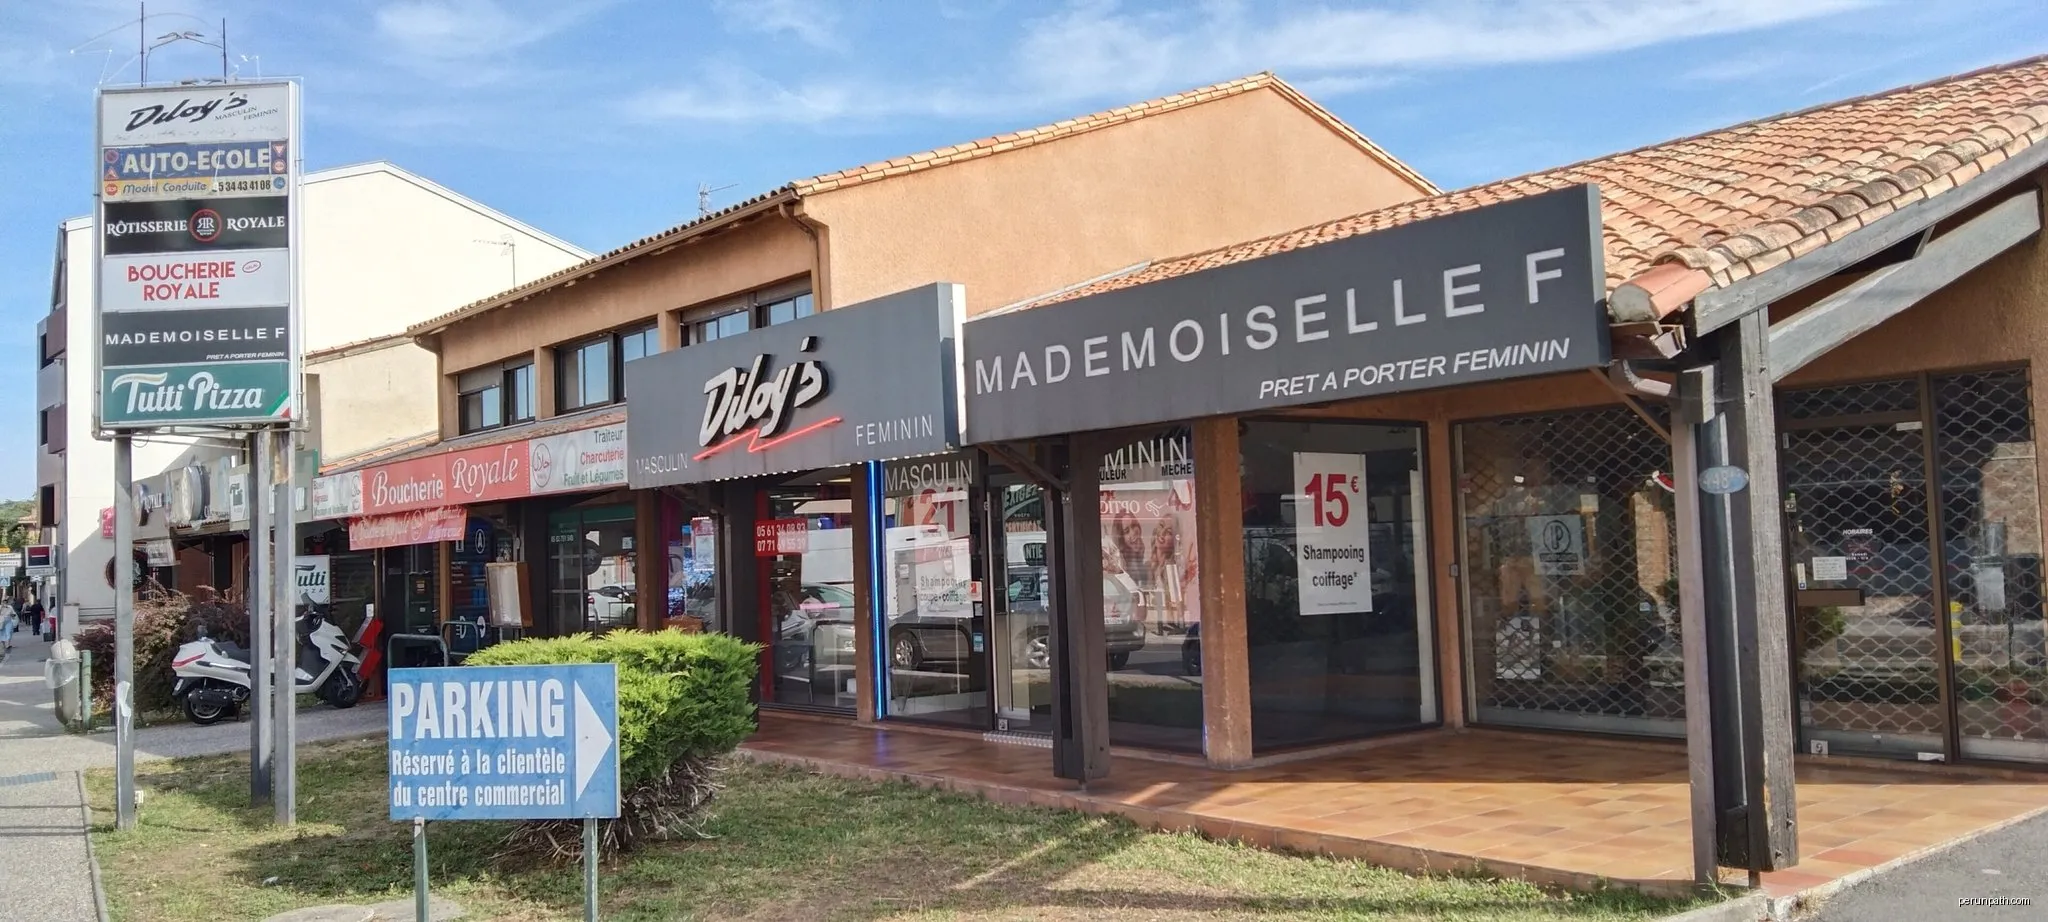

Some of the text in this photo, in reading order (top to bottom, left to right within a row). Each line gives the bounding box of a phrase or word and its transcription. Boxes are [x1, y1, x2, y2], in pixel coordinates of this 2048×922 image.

[215, 106, 257, 121] MASCULIN
[243, 108, 278, 121] FEMININ
[123, 148, 270, 173] AUTO-ECOLE
[163, 180, 207, 192] Conduite
[225, 181, 236, 191] 34
[237, 180, 248, 191] 43
[249, 180, 259, 190] 41
[106, 219, 188, 237] RÔTISSERIE
[226, 216, 286, 232] ROYALE
[128, 261, 236, 282] BOUCHERIE
[143, 282, 220, 301] ROYALE
[974, 248, 1565, 396] MADEMOISELLE F
[105, 327, 285, 345] MADEMOISELLE F
[1259, 338, 1570, 399] PRET A PORTER FEMININ
[111, 371, 263, 414] Tutti Pizza
[699, 336, 829, 448] Diloy's
[594, 428, 623, 443] Traiteur
[635, 414, 933, 474] MASCULIN FEMININ
[580, 448, 625, 465] Charcuterie
[1104, 436, 1187, 471] MININ
[371, 445, 519, 507] Boucherie Royale
[590, 469, 625, 484] Légumes
[885, 460, 973, 492] MASCULIN
[1100, 469, 1127, 481] ULEUR
[756, 525, 766, 537] 05
[767, 525, 775, 537] 61
[757, 540, 766, 552] 07
[767, 540, 775, 552] 71
[1303, 545, 1365, 562] Shampooing
[391, 678, 565, 740] PARKING
[392, 747, 565, 775] Réservé à la clientèle
[393, 779, 565, 807] du centre commercial
